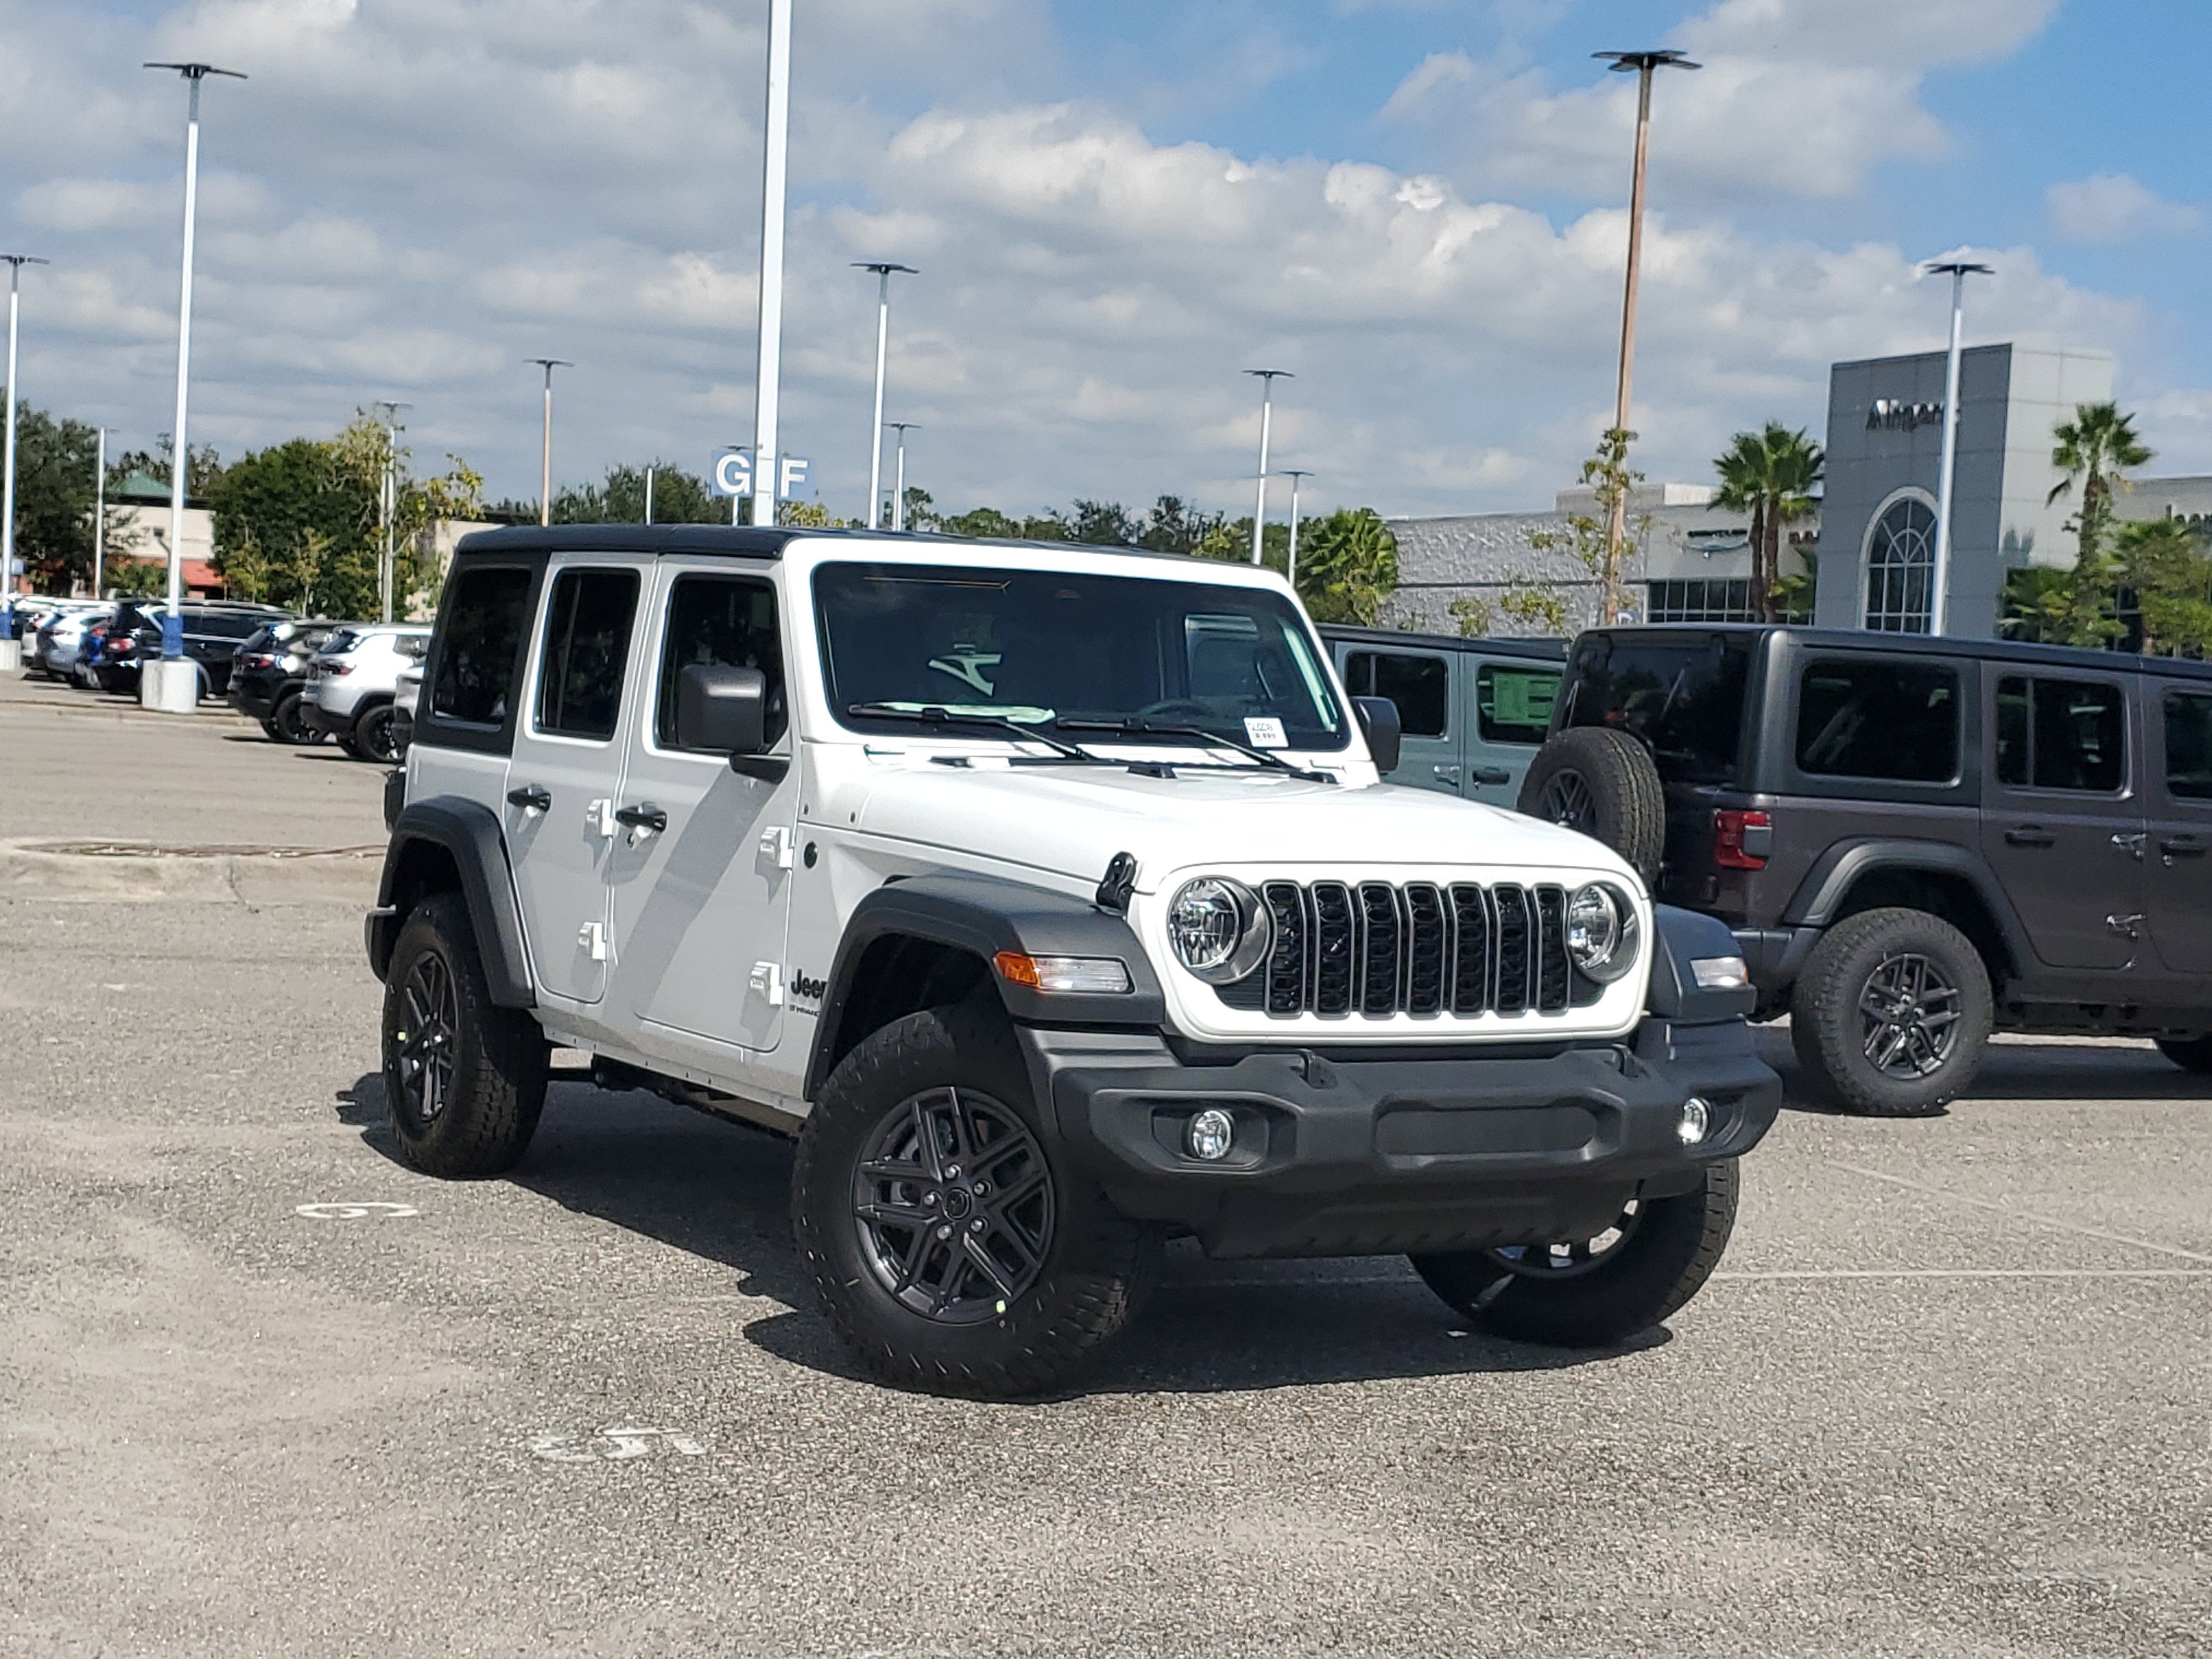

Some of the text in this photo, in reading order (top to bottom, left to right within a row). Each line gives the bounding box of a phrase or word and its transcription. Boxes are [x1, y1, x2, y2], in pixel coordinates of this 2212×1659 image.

[1866, 398, 1960, 432] Airpor
[716, 454, 751, 494] G
[780, 459, 808, 497] F
